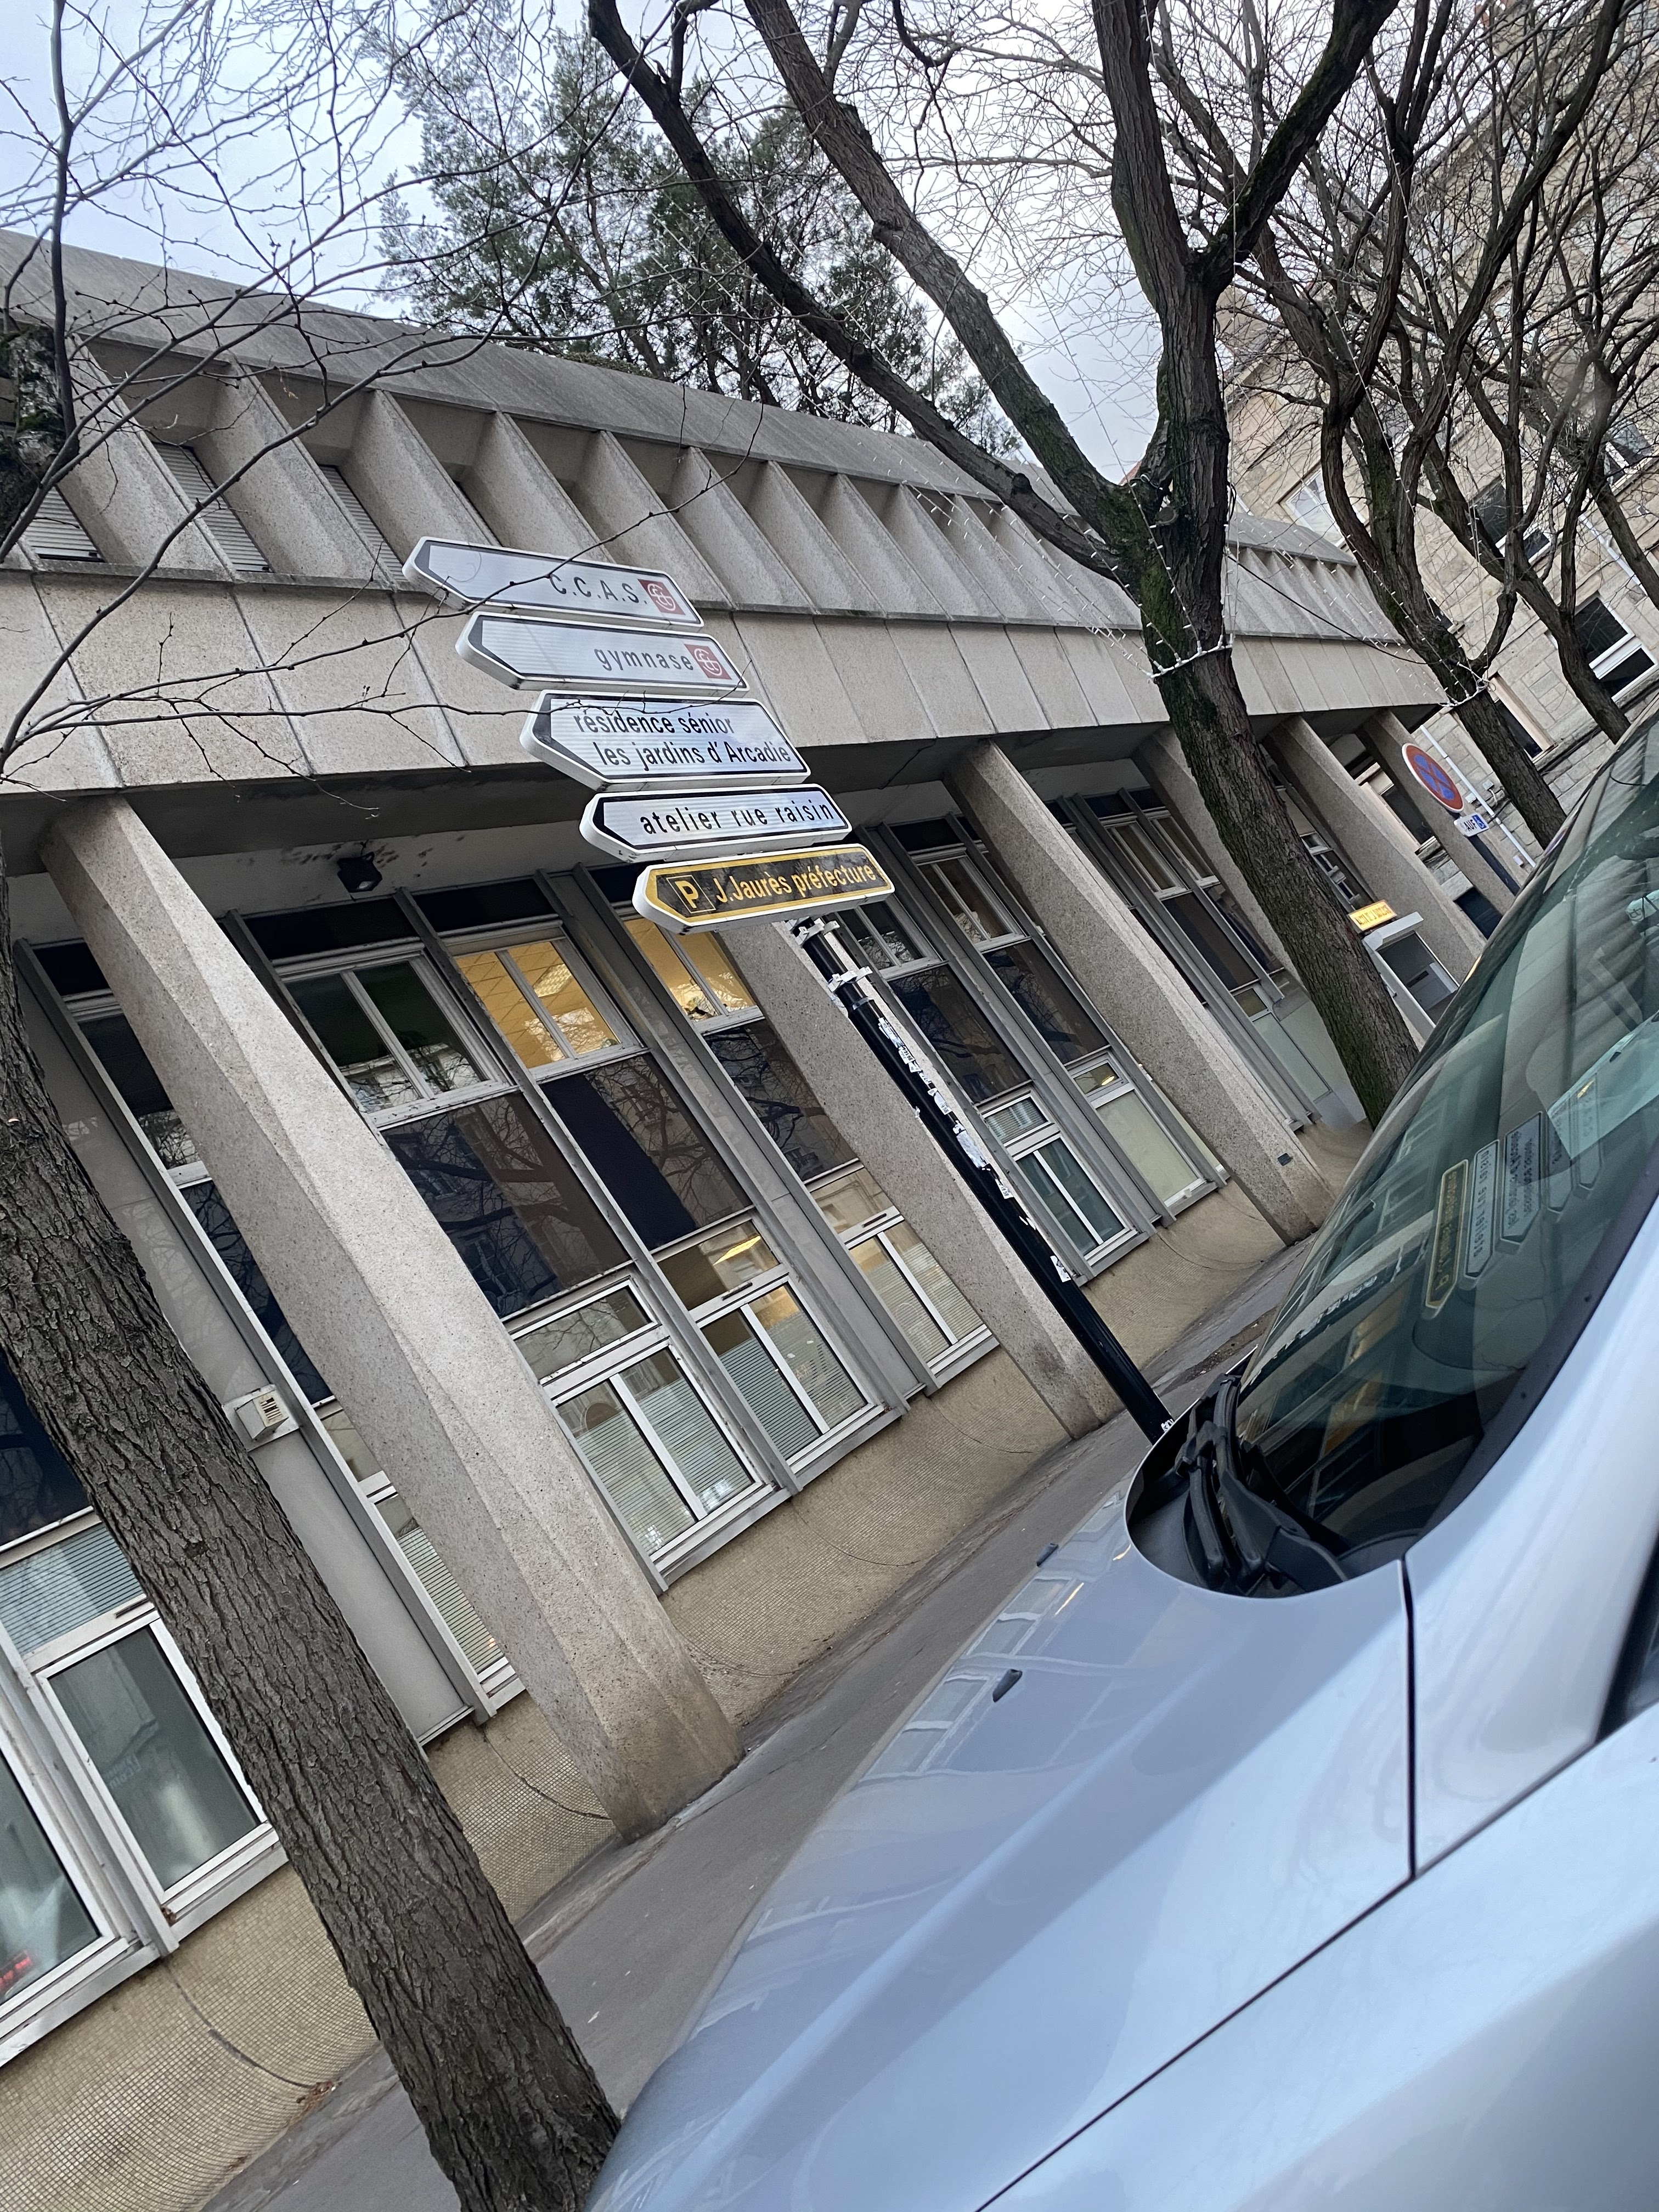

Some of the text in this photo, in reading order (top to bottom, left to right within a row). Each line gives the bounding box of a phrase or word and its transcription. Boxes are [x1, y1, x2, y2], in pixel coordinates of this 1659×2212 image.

[549, 573, 647, 604] C.C.A.S.
[594, 648, 693, 671] gymnase
[573, 710, 735, 733] résidence sénior
[593, 741, 631, 765] les
[631, 741, 705, 771] jardins
[640, 799, 833, 834] atelier rue raisin
[674, 865, 876, 909] P J.Jaurès préfecture
